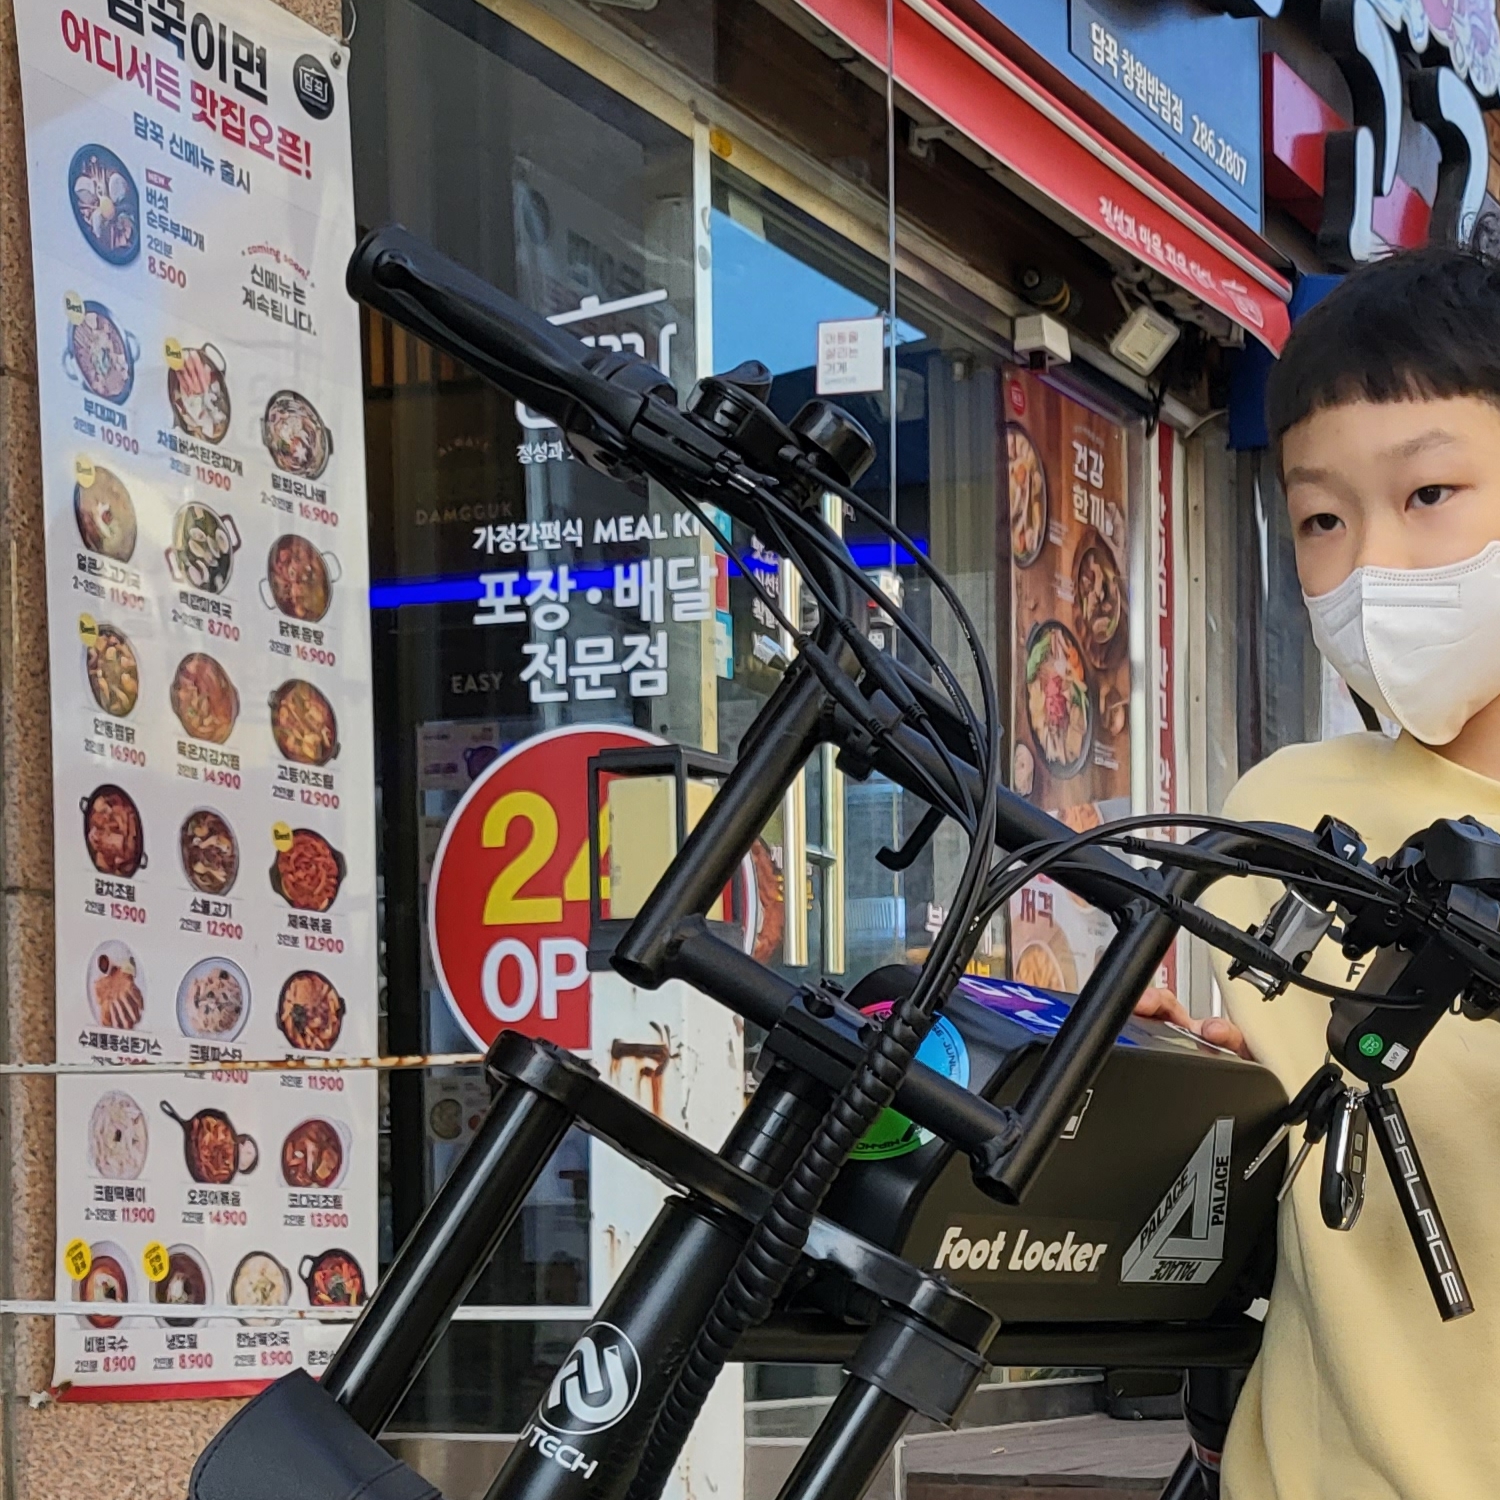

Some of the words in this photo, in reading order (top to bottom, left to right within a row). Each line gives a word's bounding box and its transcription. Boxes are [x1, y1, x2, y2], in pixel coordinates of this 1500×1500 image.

[60, 9, 182, 114] 어디서든
[190, 79, 313, 181] 맛집오픈!
[1091, 22, 1119, 80] 담꾹
[1121, 48, 1184, 136] 창원반림점
[1191, 114, 1248, 188] 286.2807
[133, 110, 165, 150] 담꾹
[169, 131, 216, 176] 신메뉴
[220, 157, 251, 195] 출시
[145, 185, 169, 214] 버섯
[145, 208, 205, 253] 순두부찌개
[146, 234, 174, 260] 2인분
[250, 263, 308, 307] 신메뉴는
[241, 285, 318, 337] 계속됩니다.
[516, 438, 565, 465] 정성과
[1072, 438, 1105, 490] 건강
[471, 517, 584, 556] 가정간편식
[592, 511, 669, 546] MEAL
[450, 671, 503, 694] EASY
[519, 630, 670, 704] 전문점
[1139, 1165, 1190, 1252] PALACE
[1210, 1155, 1230, 1227] PALACE
[1382, 1111, 1465, 1306] PALACE
[933, 1226, 1007, 1272] Foot
[1008, 1228, 1109, 1273] Locker
[1148, 1260, 1203, 1283] PALACE
